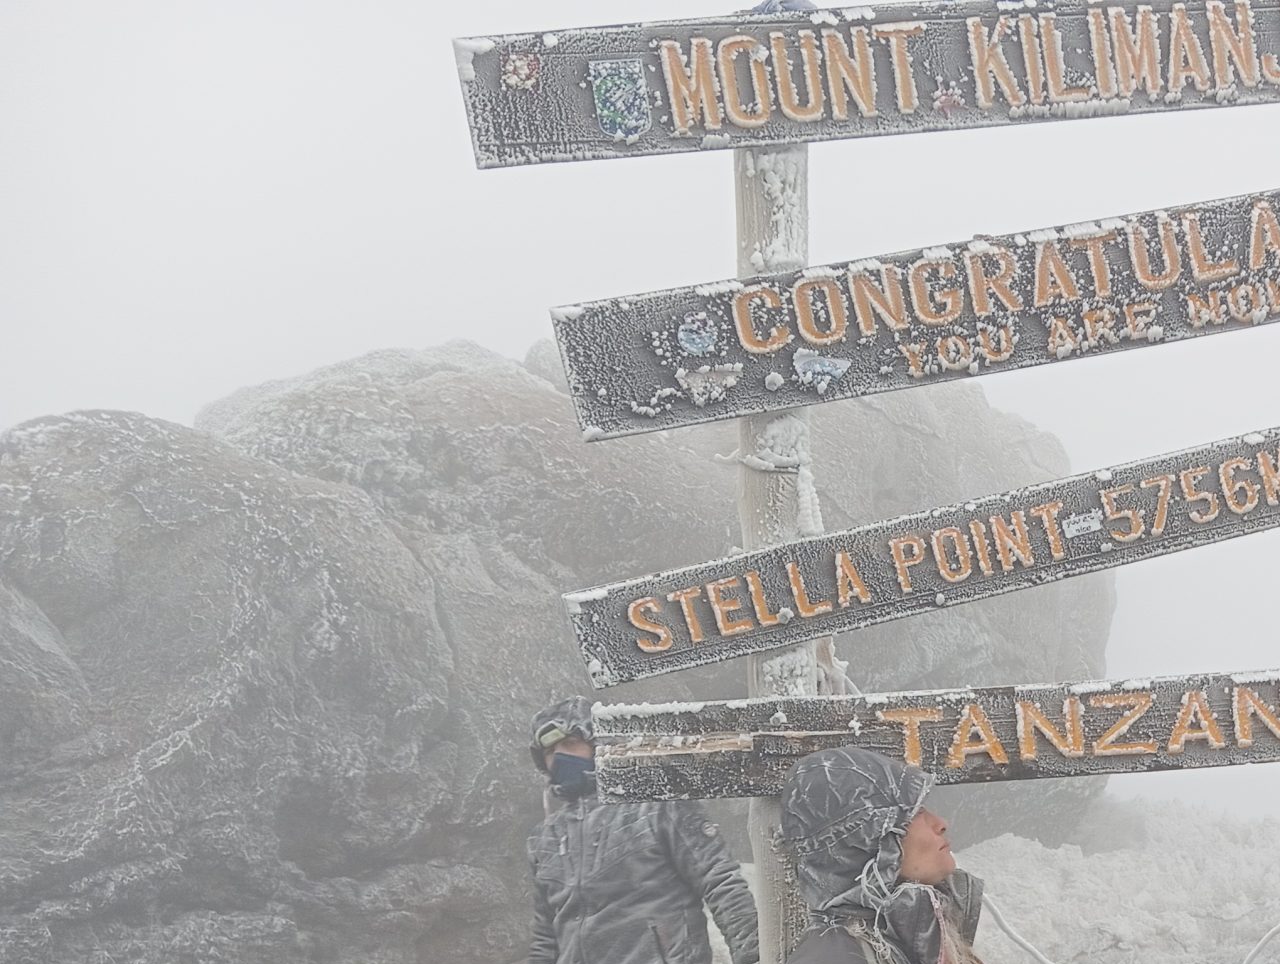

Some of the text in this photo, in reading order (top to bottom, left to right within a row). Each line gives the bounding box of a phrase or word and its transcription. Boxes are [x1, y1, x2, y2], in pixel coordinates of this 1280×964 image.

[661, 21, 926, 136] MOUNT
[898, 323, 1015, 378] YOU
[1047, 301, 1163, 357] ARE
[628, 551, 872, 654] STELLA
[888, 501, 1064, 594] POINT
